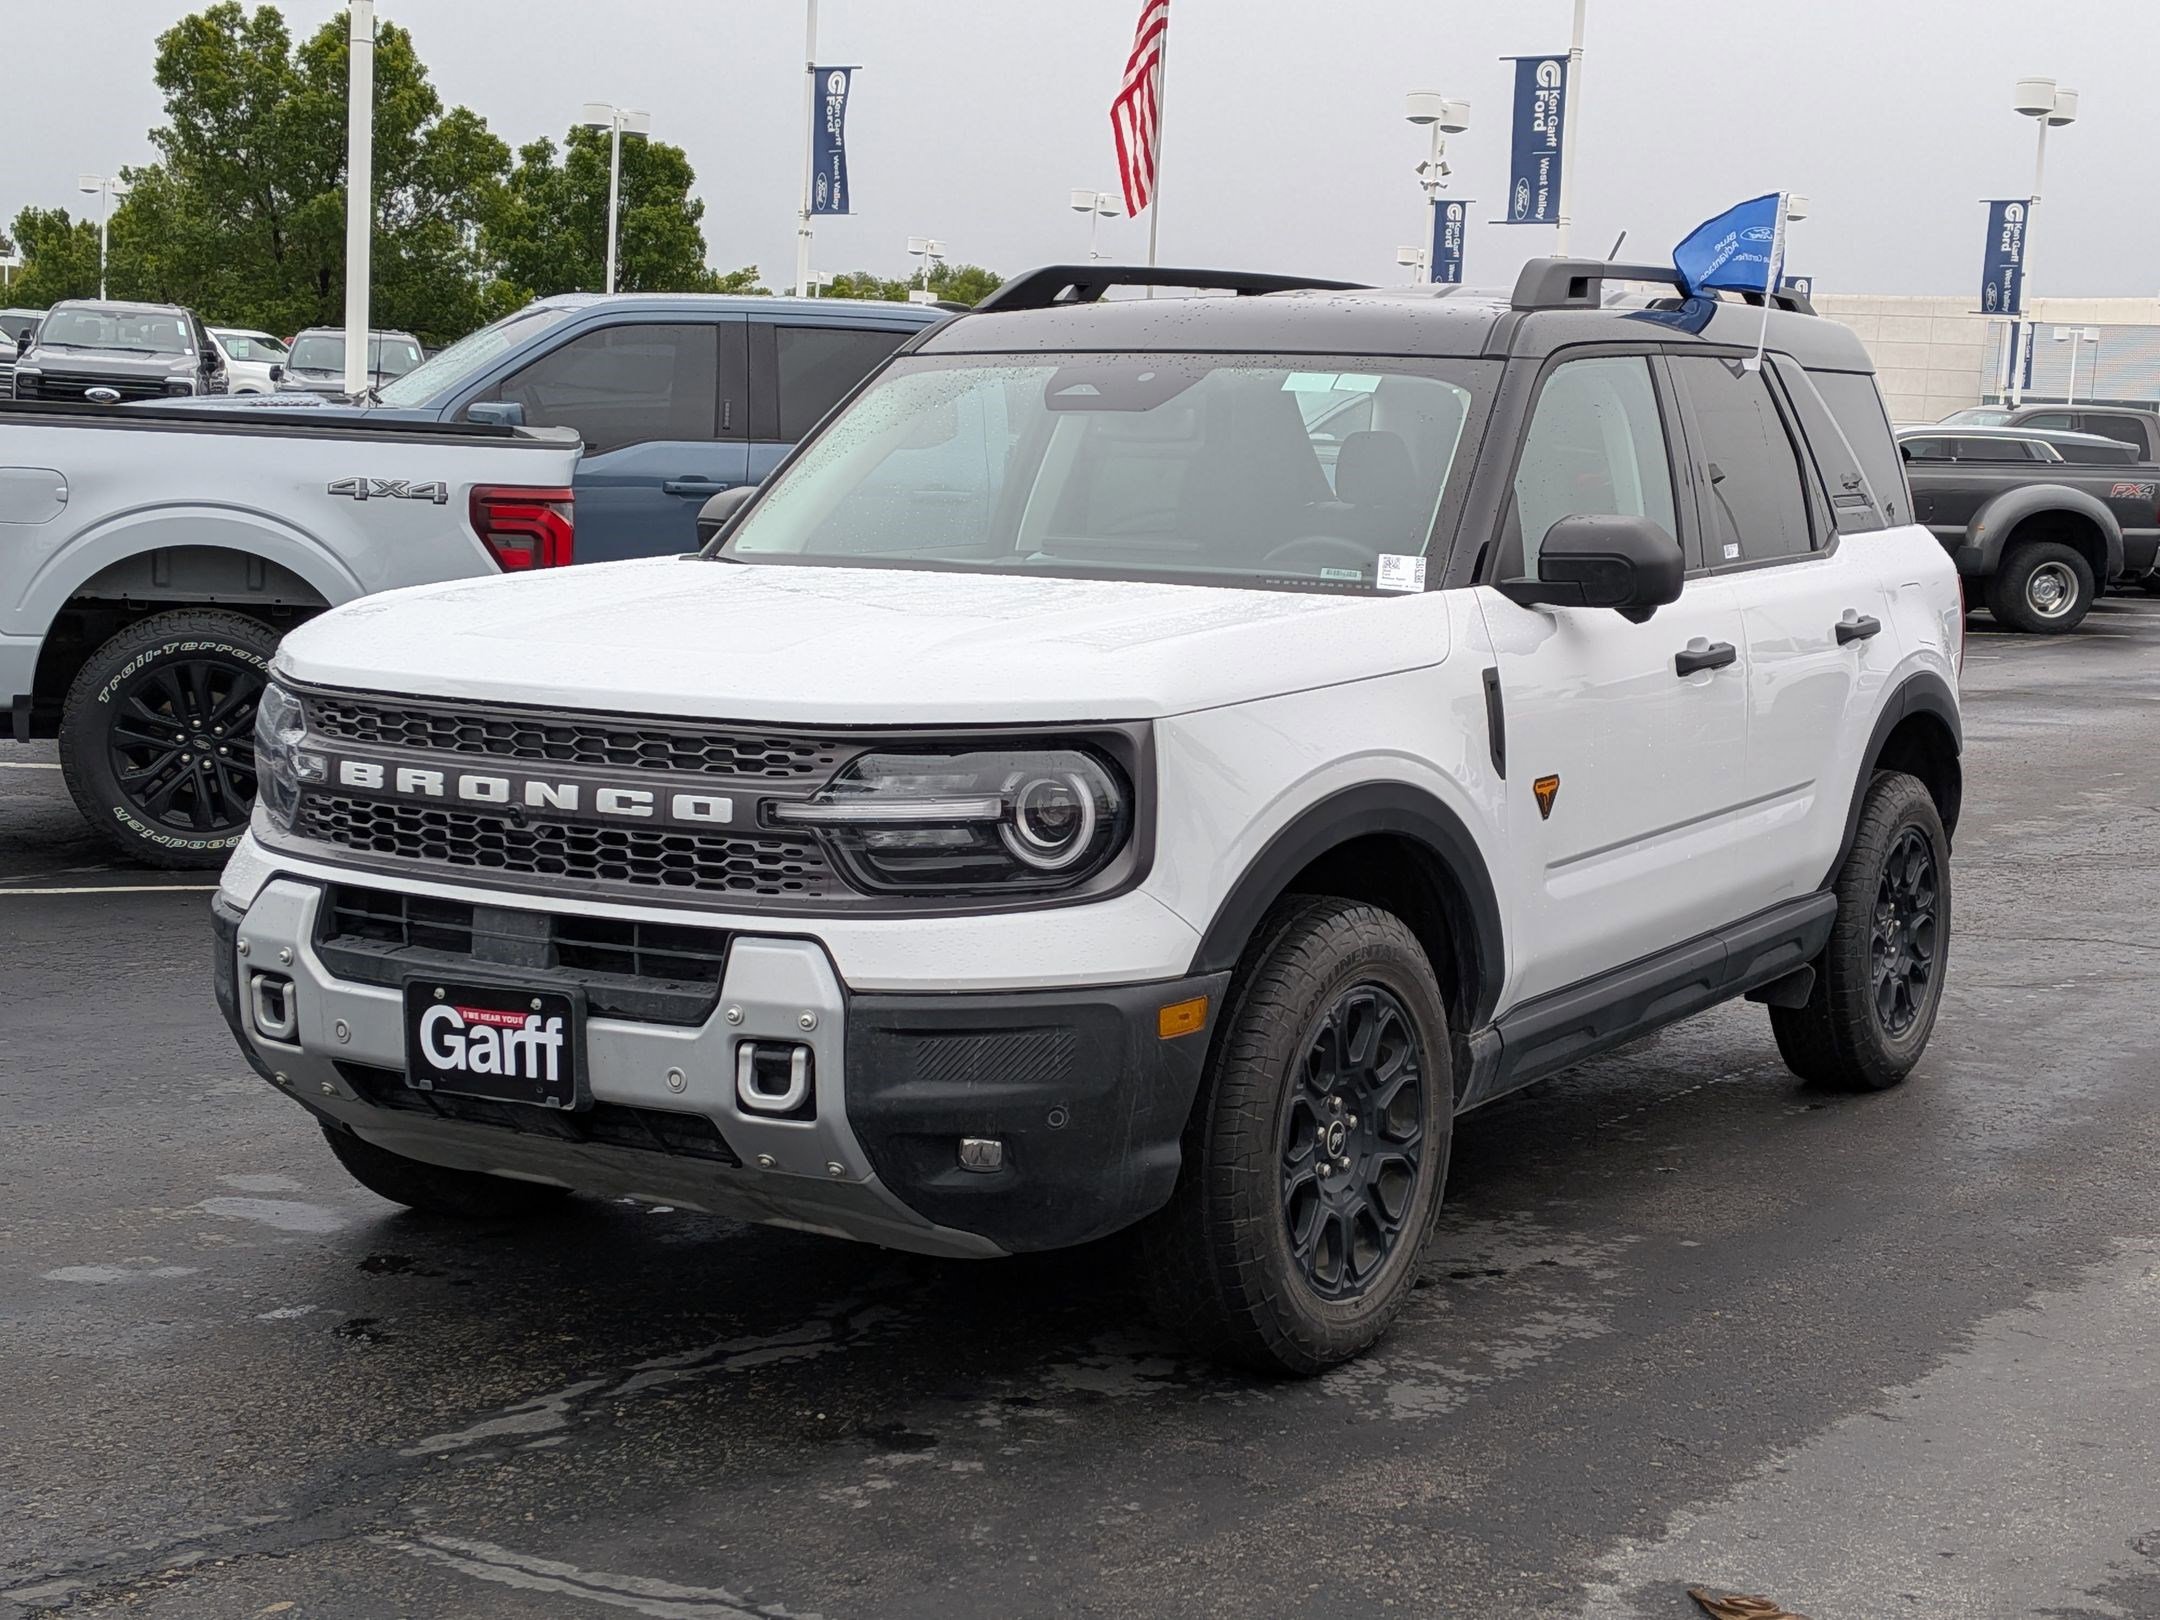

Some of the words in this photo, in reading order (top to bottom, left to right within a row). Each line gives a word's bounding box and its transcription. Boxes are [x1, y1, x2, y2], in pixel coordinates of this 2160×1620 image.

[826, 95, 836, 132] Ford
[834, 95, 844, 118] Ken
[1533, 90, 1549, 132] Ford
[1548, 89, 1561, 114] Ken
[1545, 115, 1559, 147] Garff
[1540, 157, 1550, 186] West
[1535, 187, 1548, 220] Valley
[1445, 221, 1455, 248] Ford
[1453, 222, 1462, 237] Ken
[2000, 223, 2014, 252] Ford
[2013, 223, 2023, 240] Ken
[2111, 482, 2156, 497] FX4
[340, 760, 734, 824] BRONCO
[419, 1004, 564, 1082] Garff
